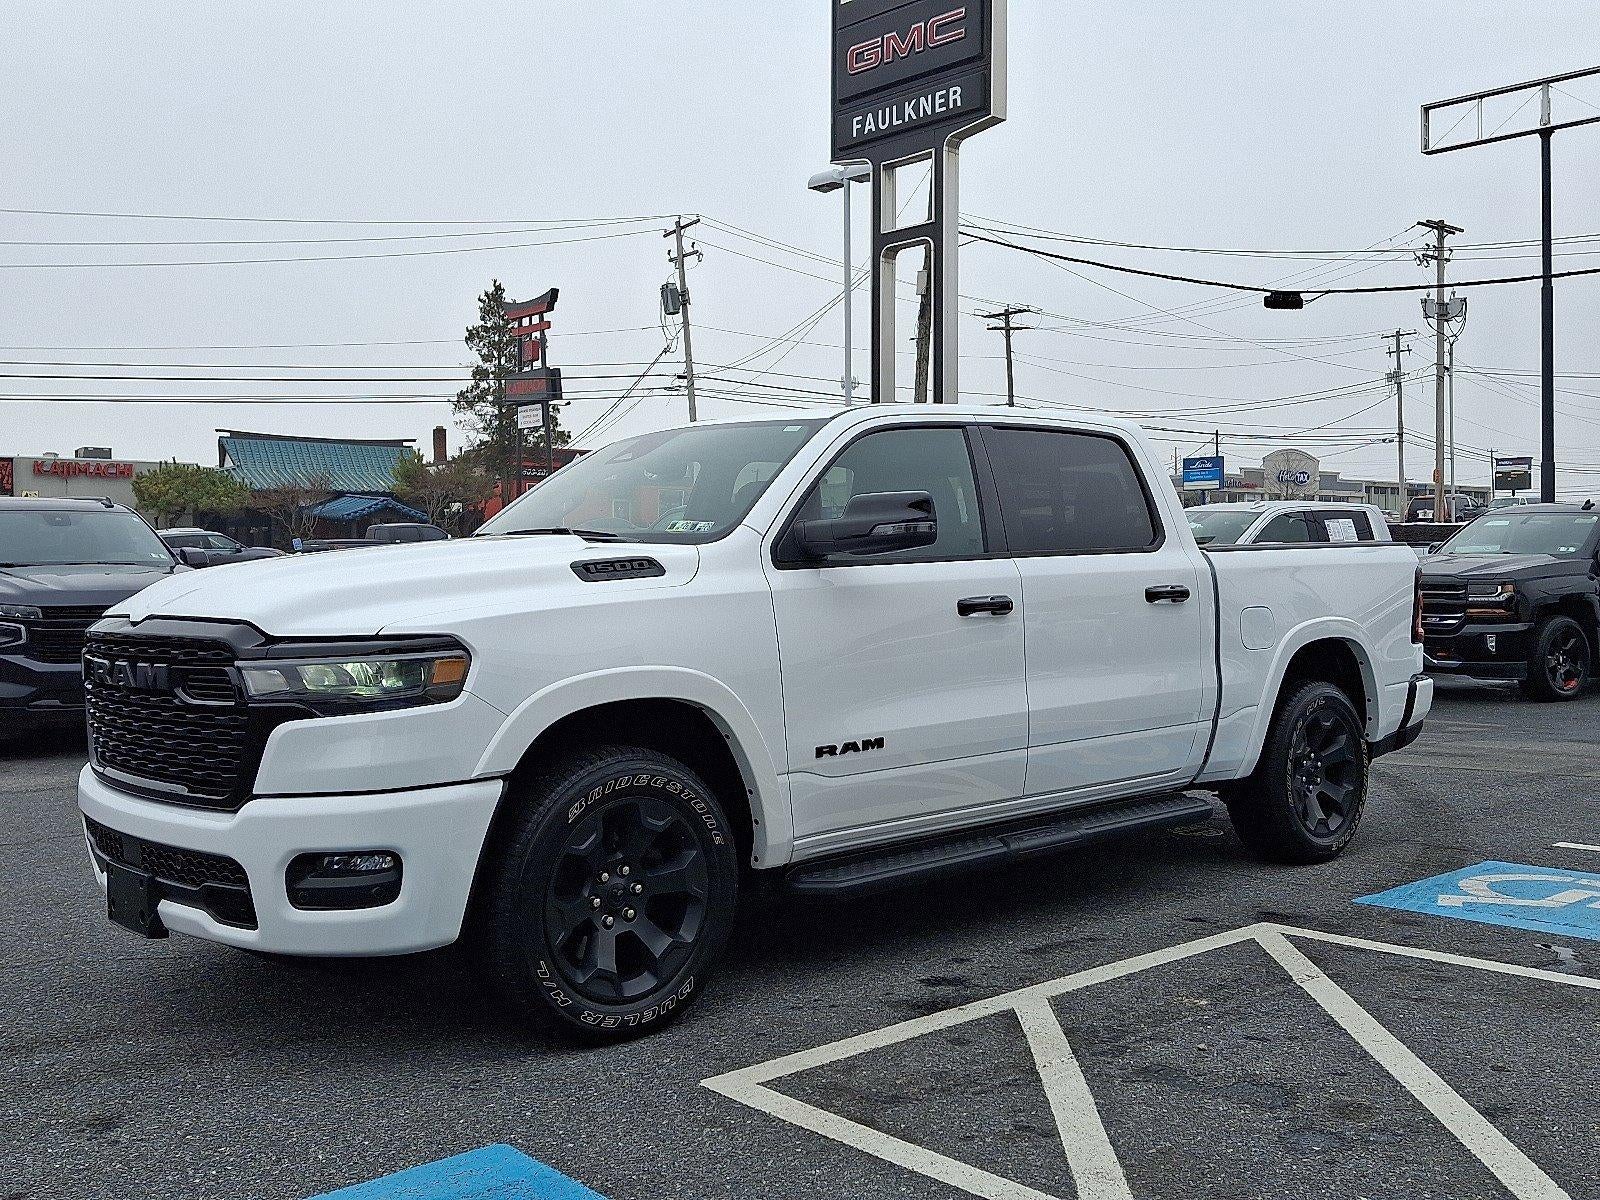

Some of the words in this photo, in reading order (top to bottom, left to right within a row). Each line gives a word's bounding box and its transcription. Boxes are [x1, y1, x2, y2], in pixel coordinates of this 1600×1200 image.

[847, 7, 966, 75] GMC
[852, 85, 962, 138] FAULKNER
[1190, 460, 1213, 469] Linde
[587, 559, 650, 574] 1500
[85, 655, 170, 689] RAM
[815, 736, 885, 759] RAM
[568, 774, 724, 846] BRIDGESTONE
[536, 960, 573, 1008] H/L
[580, 975, 695, 1028] DUELER
